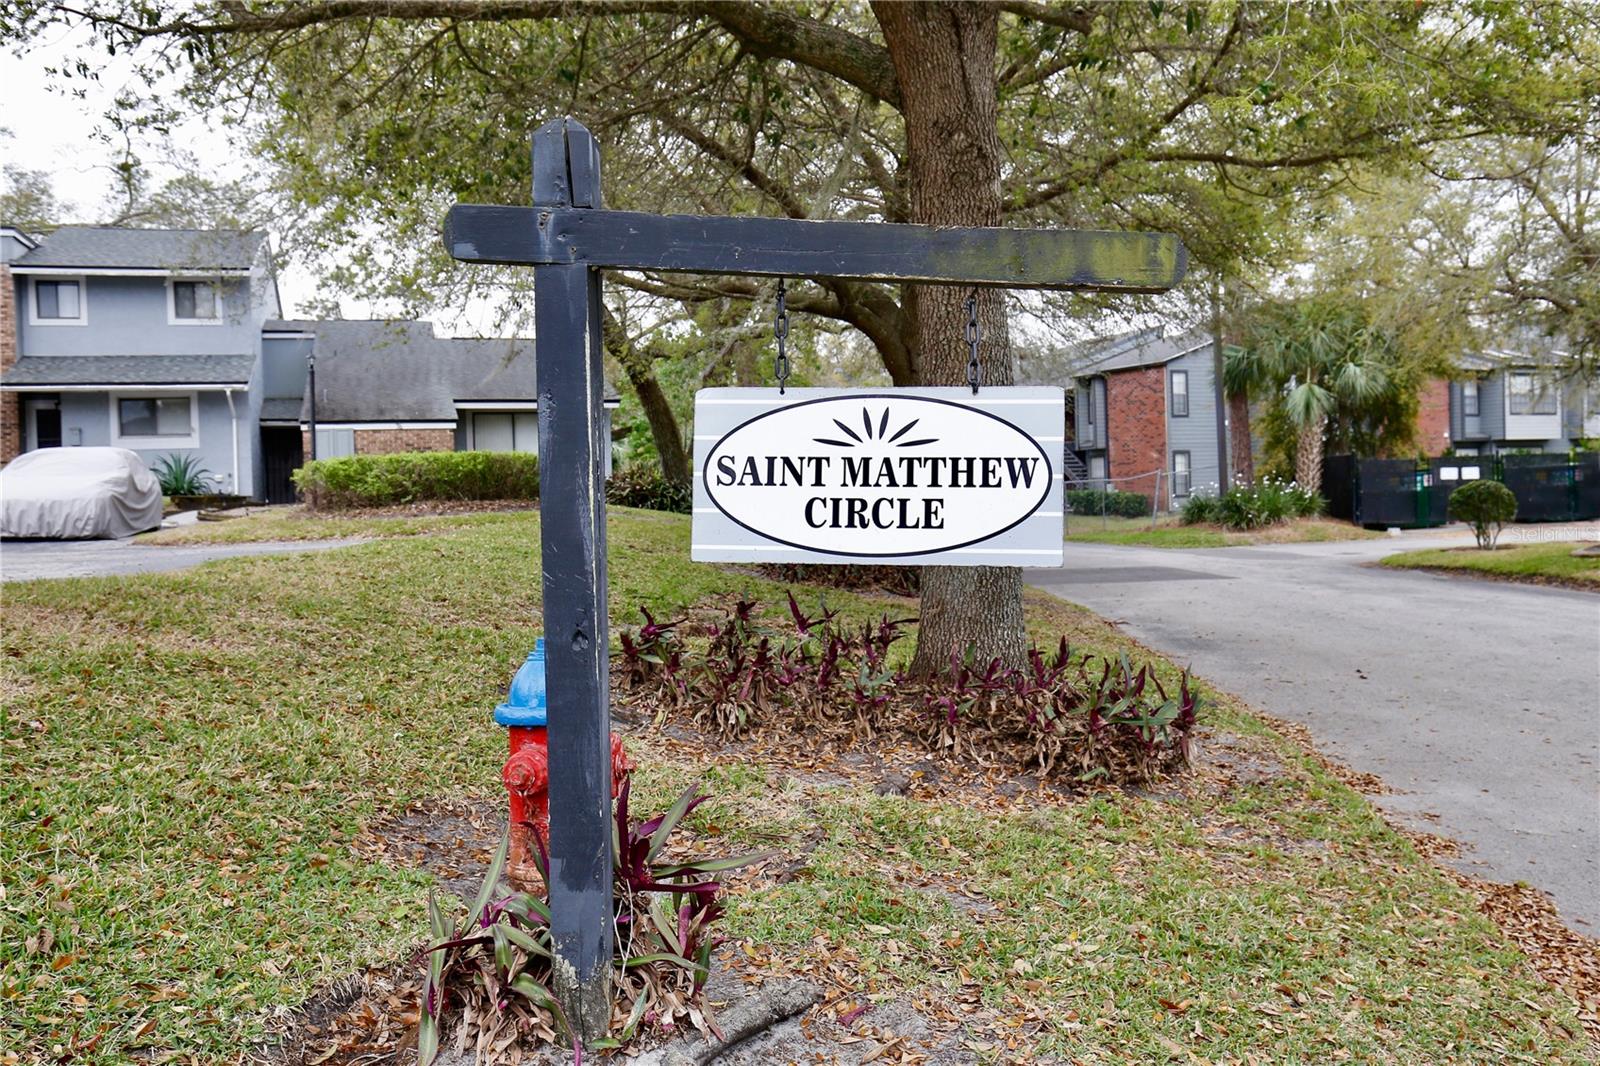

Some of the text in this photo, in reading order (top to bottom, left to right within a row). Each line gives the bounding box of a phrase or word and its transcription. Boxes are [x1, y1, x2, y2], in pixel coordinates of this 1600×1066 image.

[716, 455, 1039, 489] SAINT MATTHEW
[804, 497, 944, 529] CIRCLE
